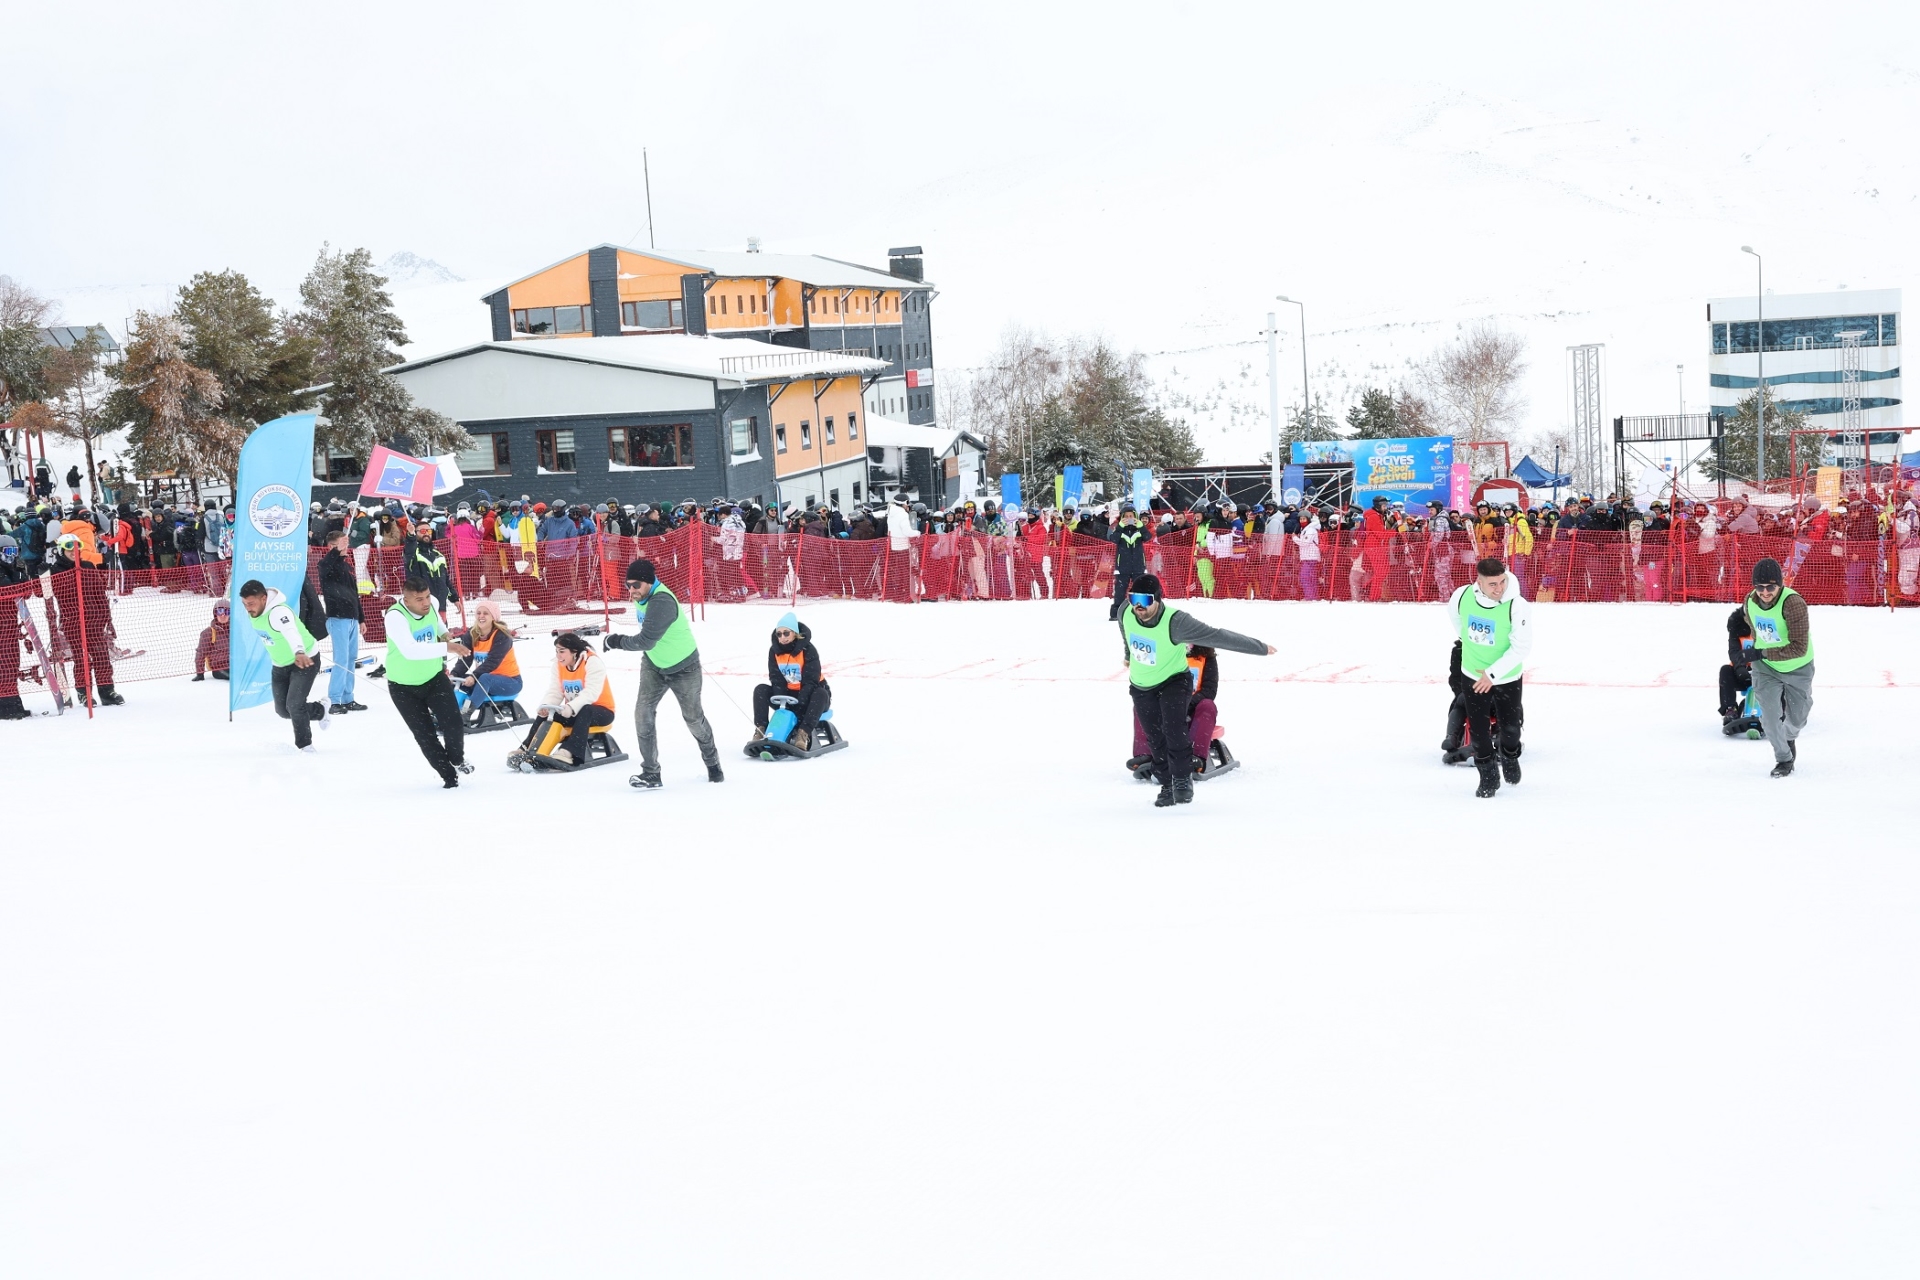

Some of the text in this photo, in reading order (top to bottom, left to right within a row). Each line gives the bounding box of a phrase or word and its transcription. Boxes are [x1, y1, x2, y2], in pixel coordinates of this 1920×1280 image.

[1471, 621, 1491, 634] 035
[1757, 622, 1774, 633] 015
[1132, 640, 1152, 653] 020
[564, 685, 581, 694] 019
